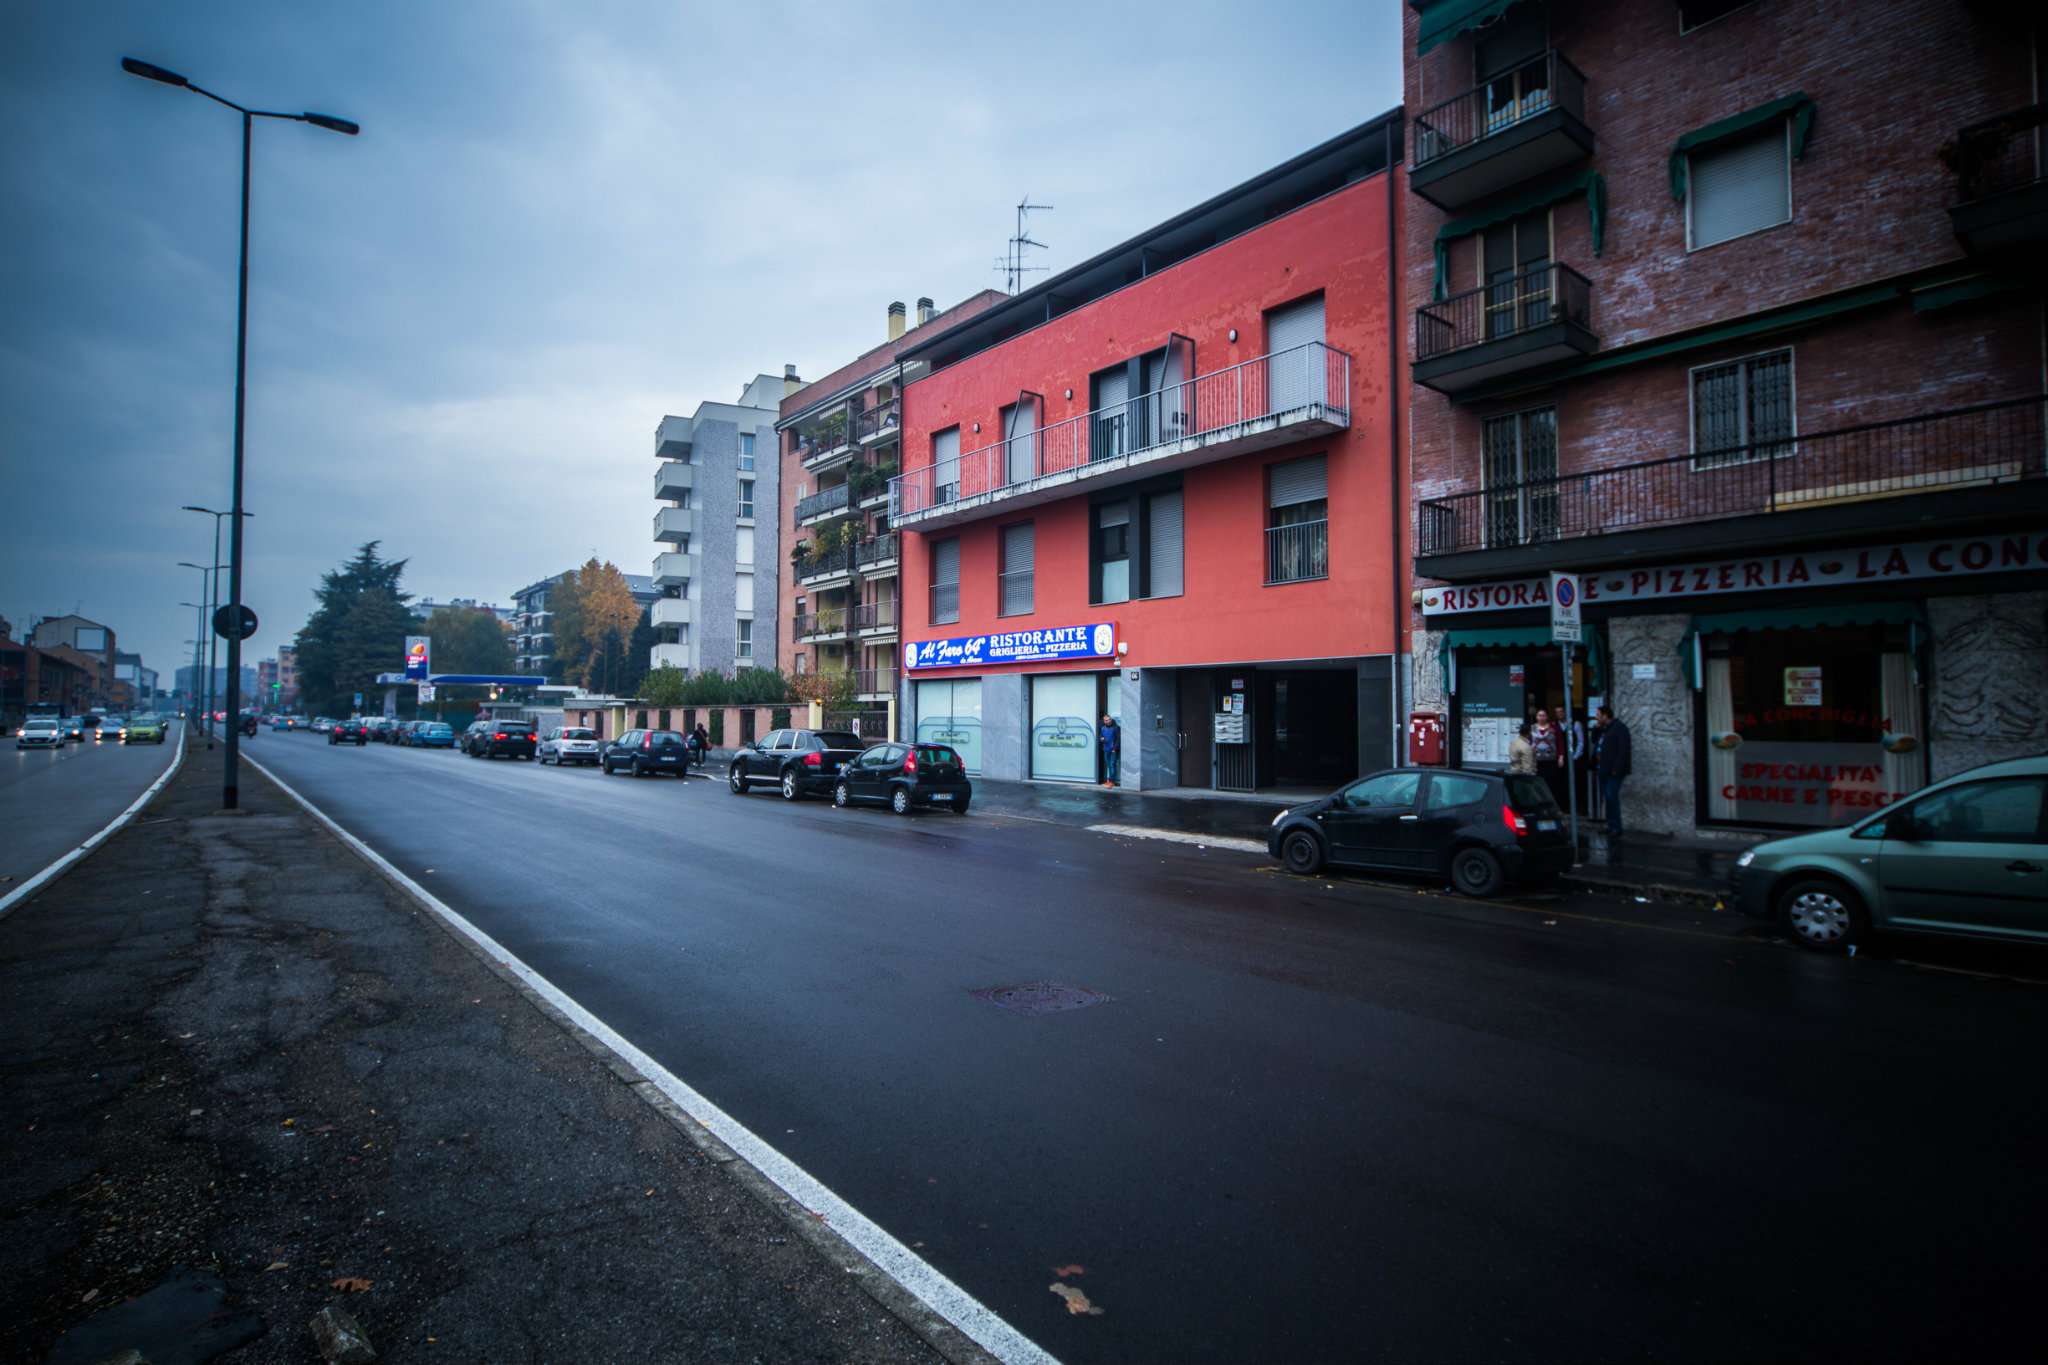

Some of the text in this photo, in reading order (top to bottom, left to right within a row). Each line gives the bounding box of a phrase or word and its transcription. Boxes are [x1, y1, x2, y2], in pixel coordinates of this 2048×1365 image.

[1443, 576, 1600, 610] RISTORAE
[1631, 556, 1810, 596] PIZZERIA
[1857, 548, 1910, 579] LA
[990, 627, 1087, 648] RISTORANTE
[919, 642, 935, 660] Al
[990, 644, 1039, 657] GRIGLIERIA
[1045, 642, 1087, 653] PIZZERIA
[1722, 784, 1795, 804] CARNE
[1805, 788, 1819, 805] E
